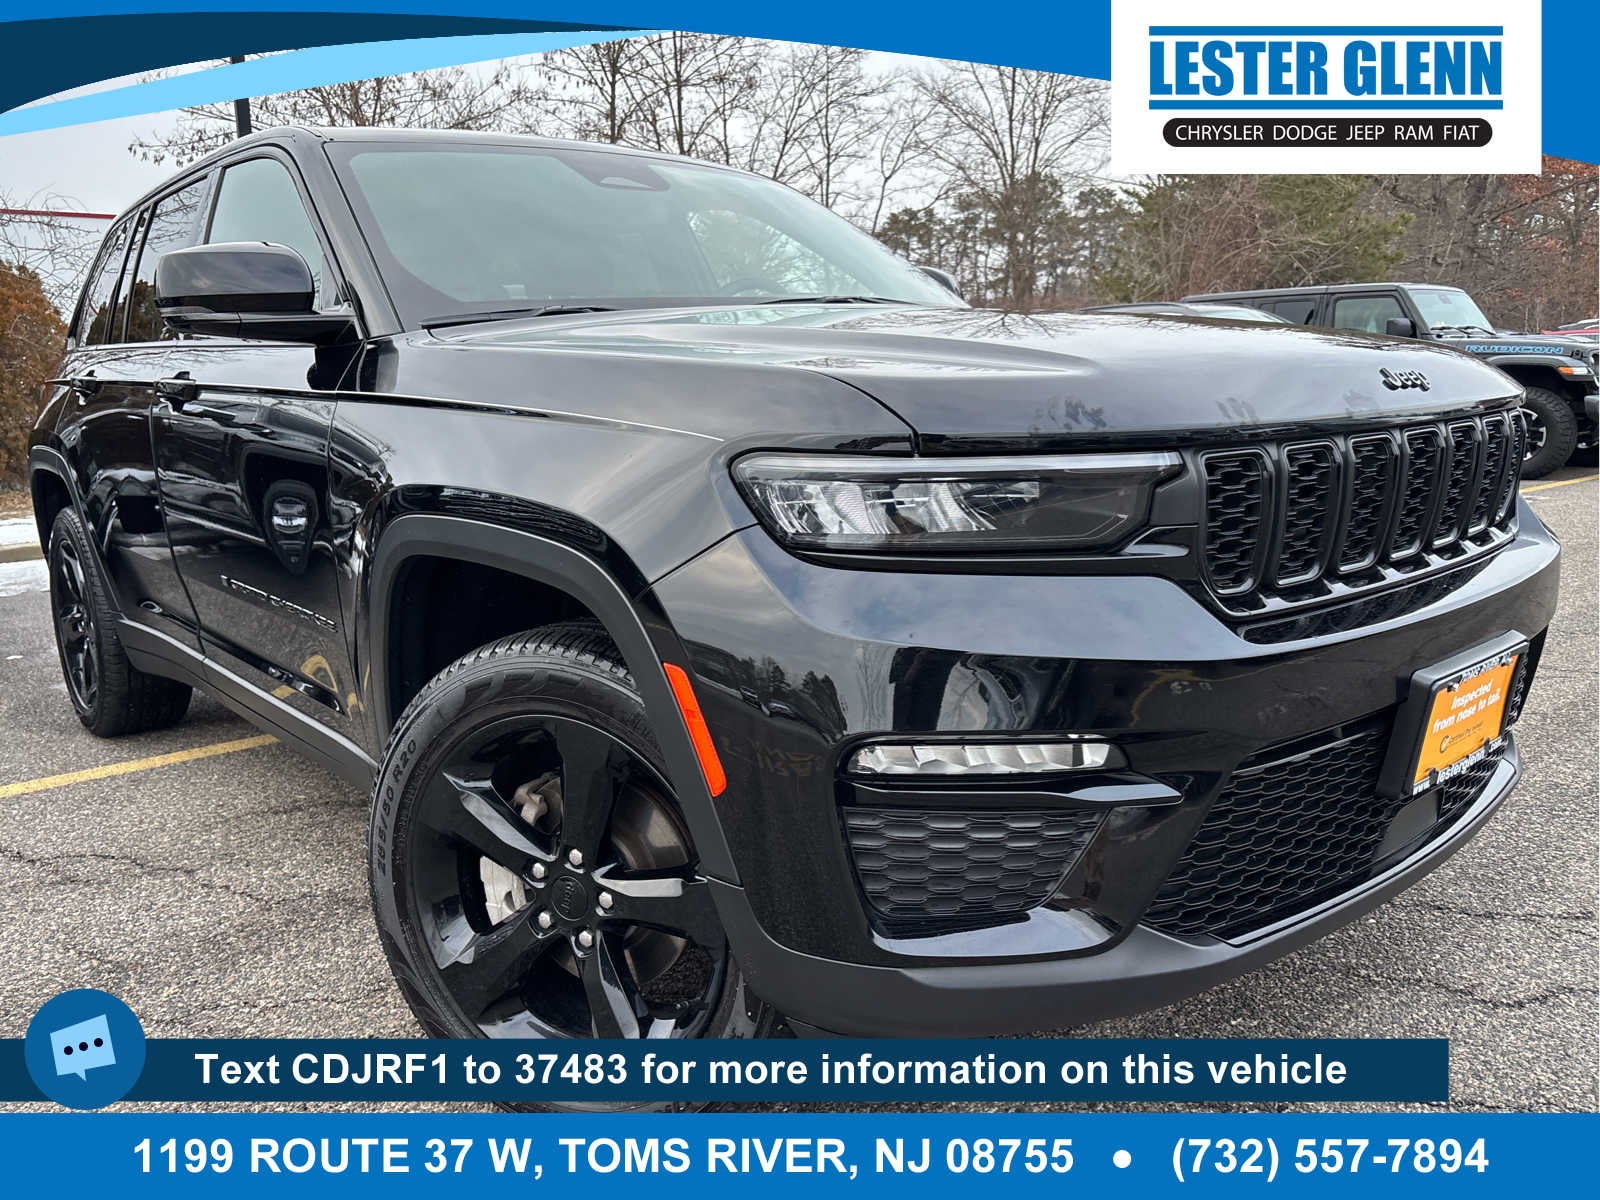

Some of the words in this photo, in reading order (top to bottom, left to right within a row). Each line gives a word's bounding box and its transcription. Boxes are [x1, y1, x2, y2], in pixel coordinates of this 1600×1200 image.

[1465, 344, 1564, 354] RUBICON
[1379, 368, 1430, 392] Jeep
[1432, 714, 1456, 735] from
